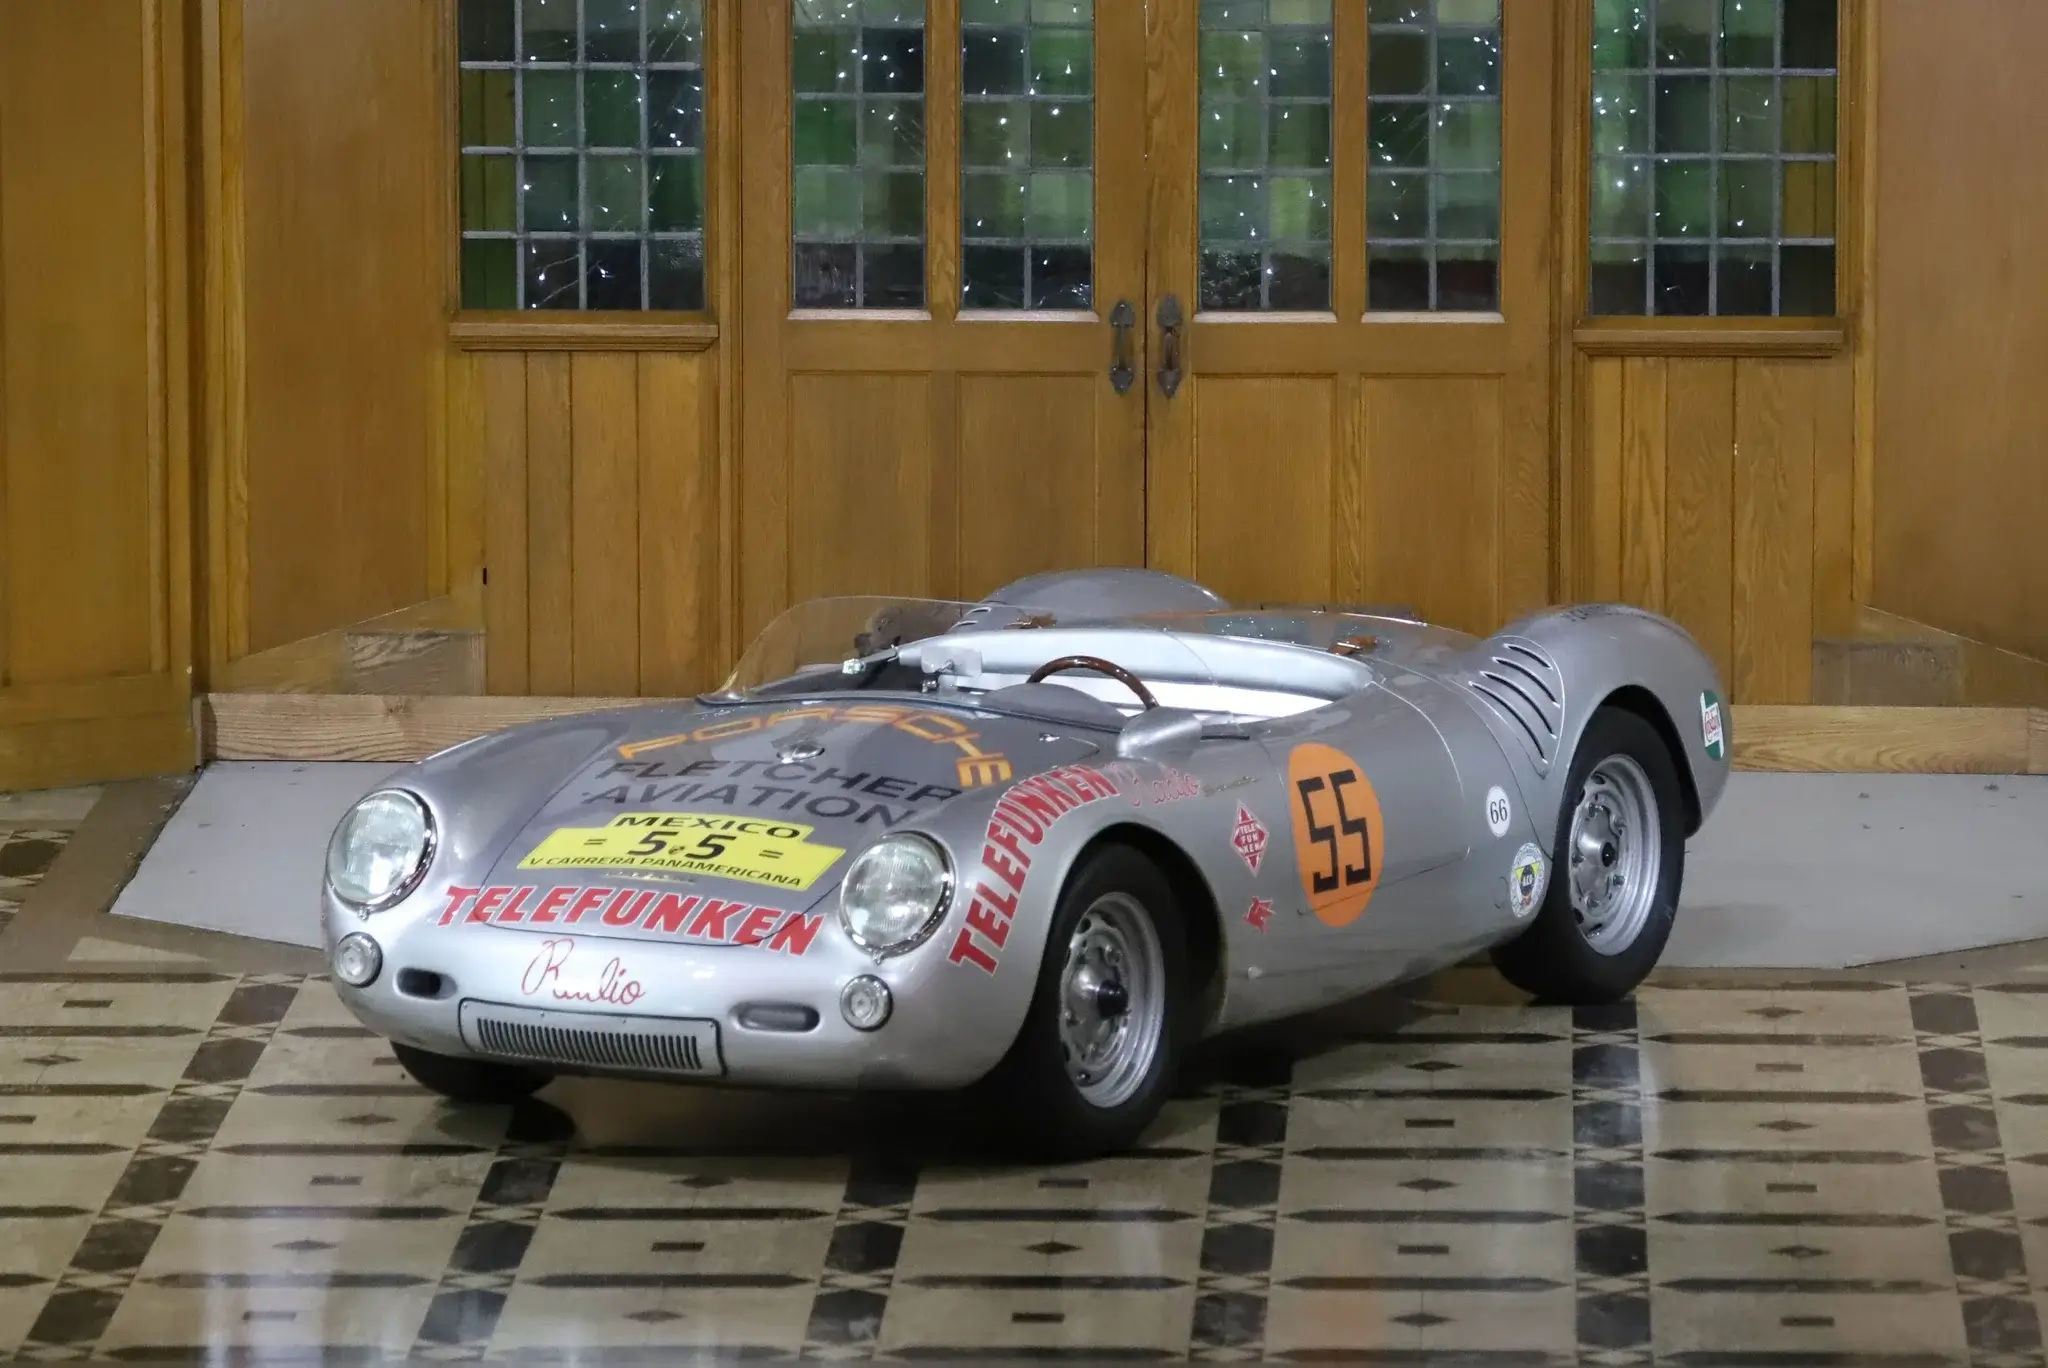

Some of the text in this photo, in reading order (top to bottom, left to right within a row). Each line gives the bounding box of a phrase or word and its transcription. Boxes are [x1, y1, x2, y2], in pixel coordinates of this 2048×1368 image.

[617, 706, 1013, 787] PORSCHE
[597, 760, 963, 803] FLETCHER
[585, 783, 916, 827] AVIATION
[1490, 798, 1508, 825] 66
[616, 817, 800, 840] MEXICO
[1297, 768, 1371, 895] 55
[530, 858, 542, 866] V
[544, 857, 636, 867] CARRERA
[639, 857, 801, 887] PANAMERICANA
[947, 762, 1121, 976] TELEFUNKEN
[436, 885, 825, 957] TELEFUNKEN
